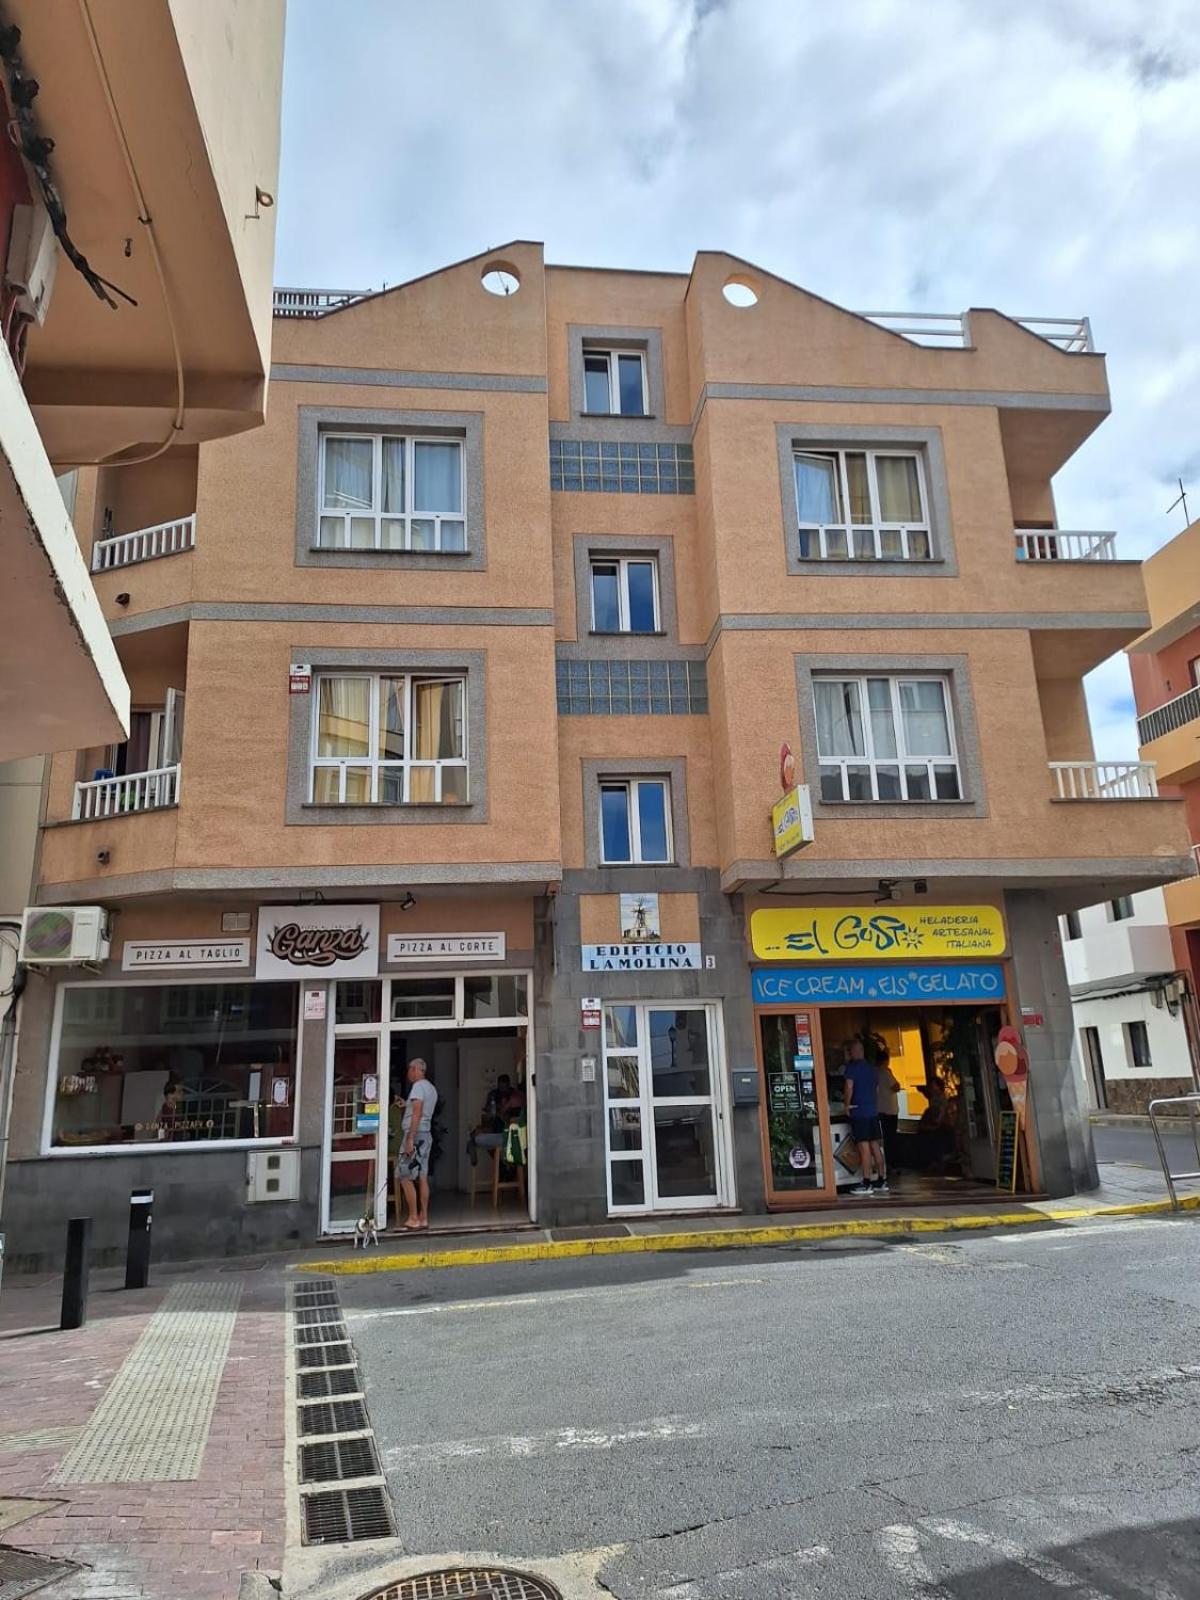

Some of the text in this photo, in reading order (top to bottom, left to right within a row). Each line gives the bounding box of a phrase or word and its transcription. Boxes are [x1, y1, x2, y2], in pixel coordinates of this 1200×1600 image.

[919, 915, 979, 924] HELADERIA
[931, 928, 995, 937] ARTESANAL
[399, 941, 494, 952] PIZZA AL CORTE
[946, 939, 992, 948] ITALIANA
[136, 947, 240, 961] PIZZA AL TAGLIO
[596, 944, 687, 956] EDIFICIO
[707, 957, 715, 968] 3
[756, 973, 998, 997] ICE CREAM EIS GELATO
[773, 1085, 796, 1093] OPEN
